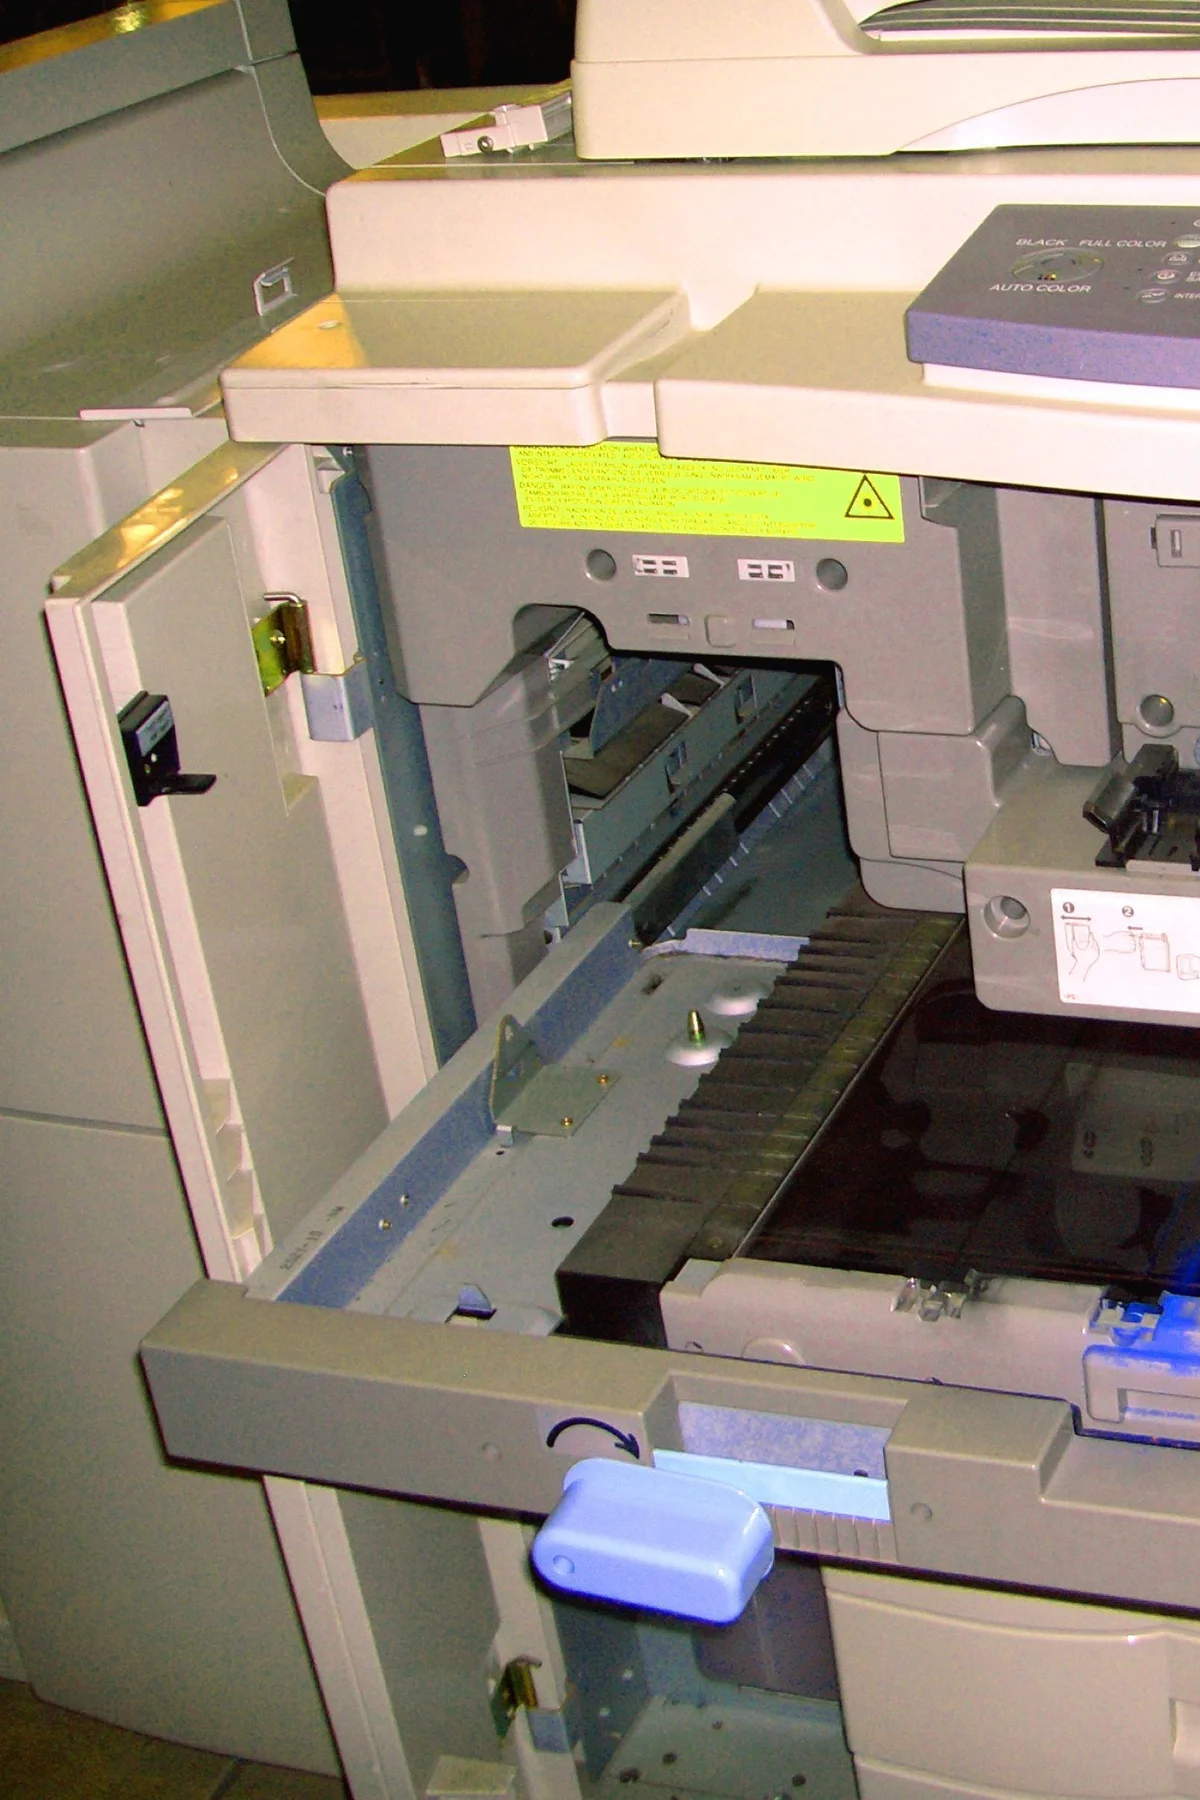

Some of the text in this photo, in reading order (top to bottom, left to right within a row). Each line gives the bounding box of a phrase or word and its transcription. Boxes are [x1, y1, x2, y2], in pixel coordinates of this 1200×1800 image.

[1016, 238, 1068, 247] BLACK
[1079, 239, 1167, 248] FULL COLOR
[989, 283, 1092, 293] AUTO COLOR
